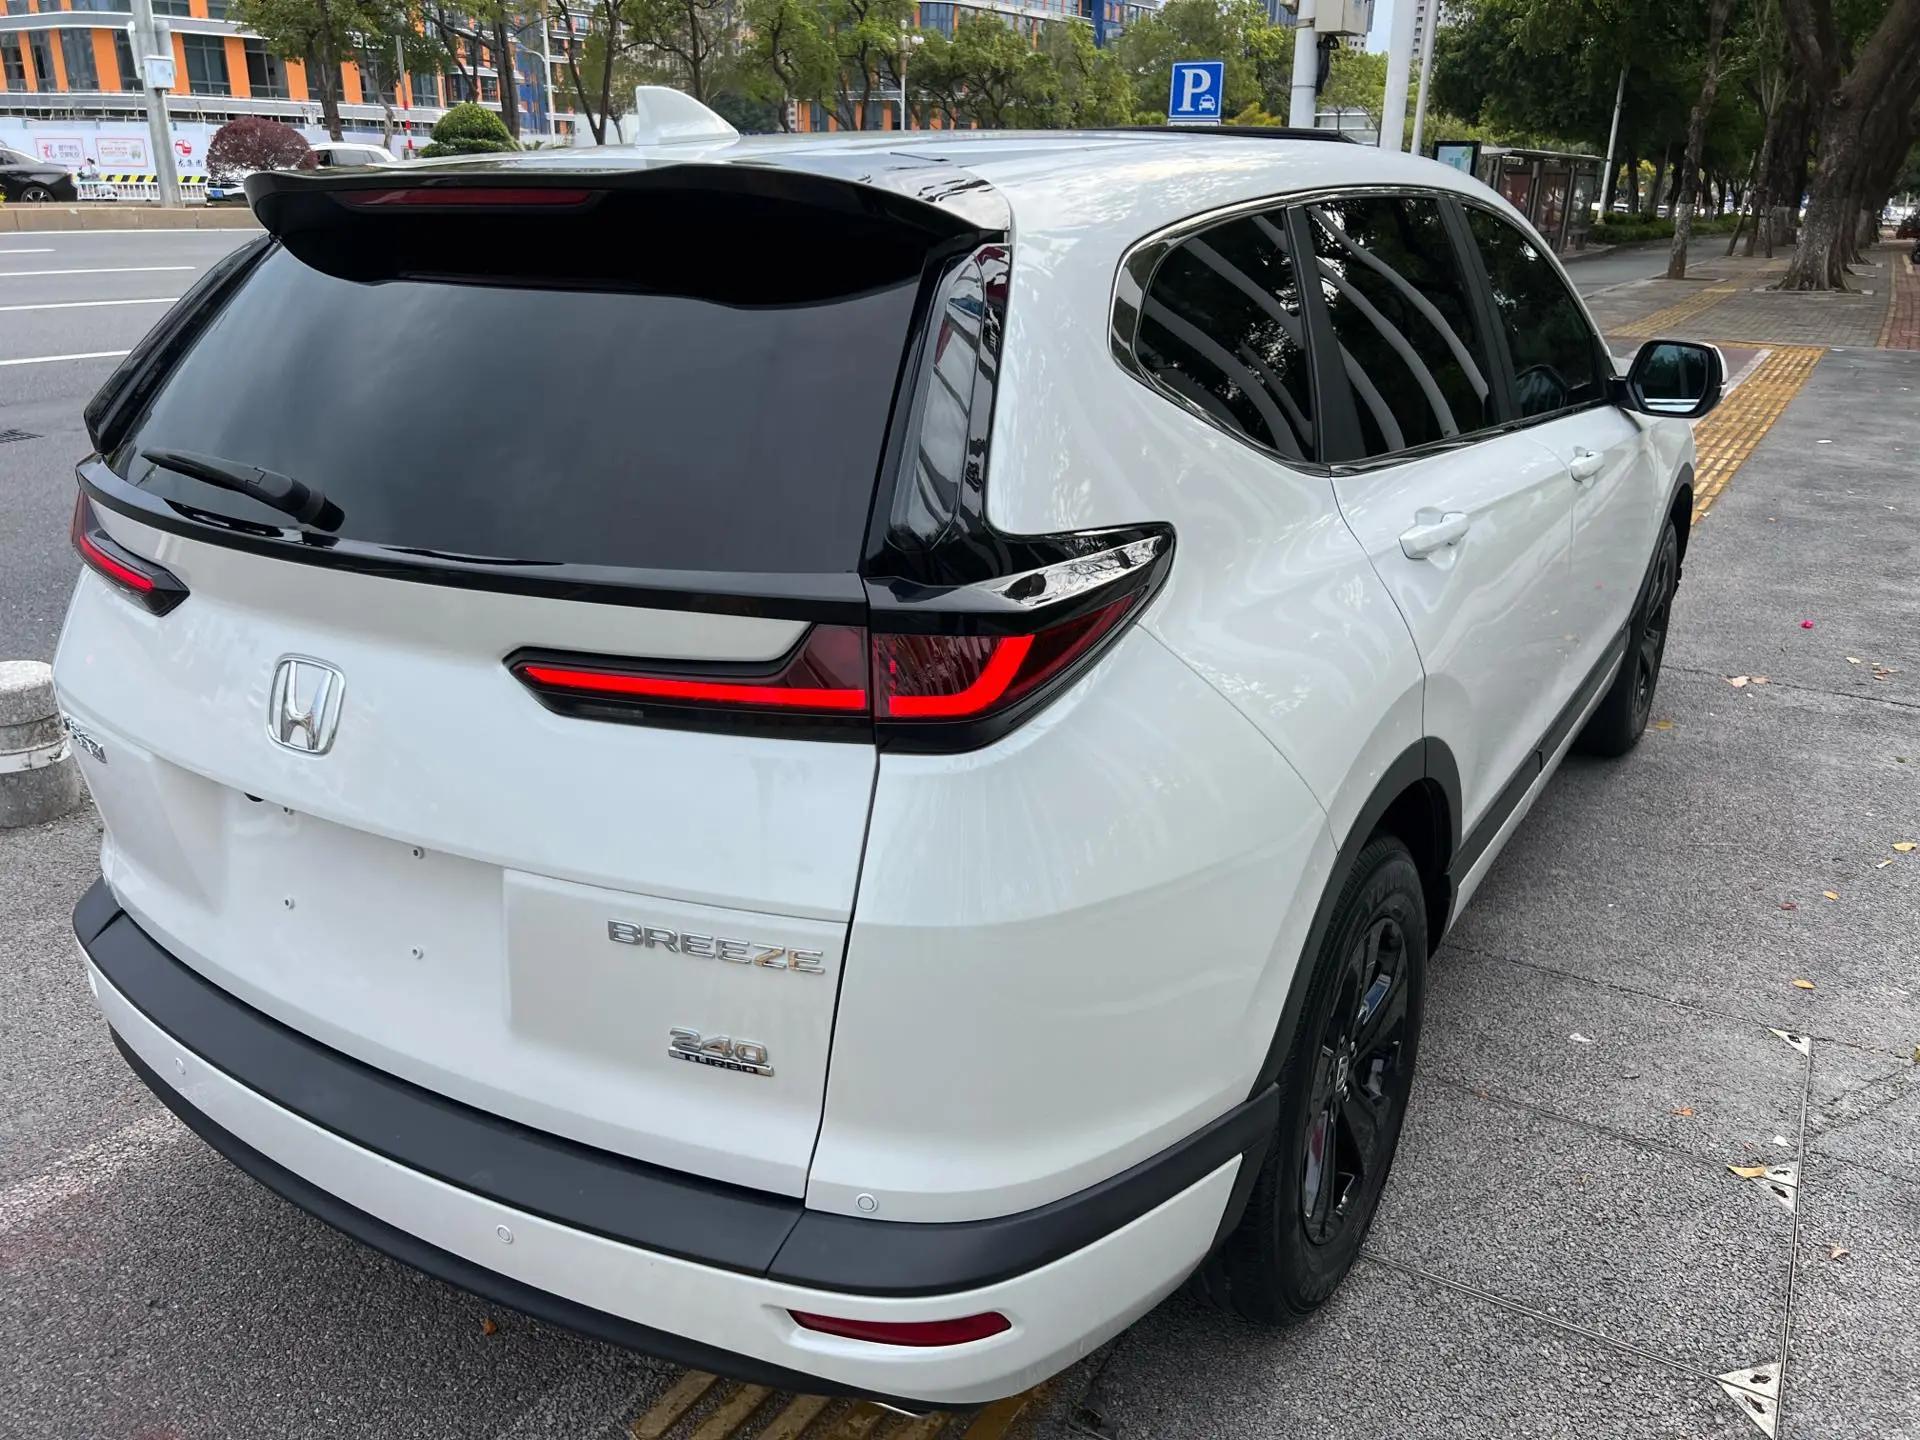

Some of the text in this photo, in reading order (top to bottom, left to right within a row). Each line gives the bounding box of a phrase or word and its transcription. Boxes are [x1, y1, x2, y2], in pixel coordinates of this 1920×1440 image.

[1177, 68, 1212, 112] P
[607, 919, 826, 974] BREEZE
[669, 1026, 768, 1064] 240
[680, 1051, 758, 1074] TURBO
